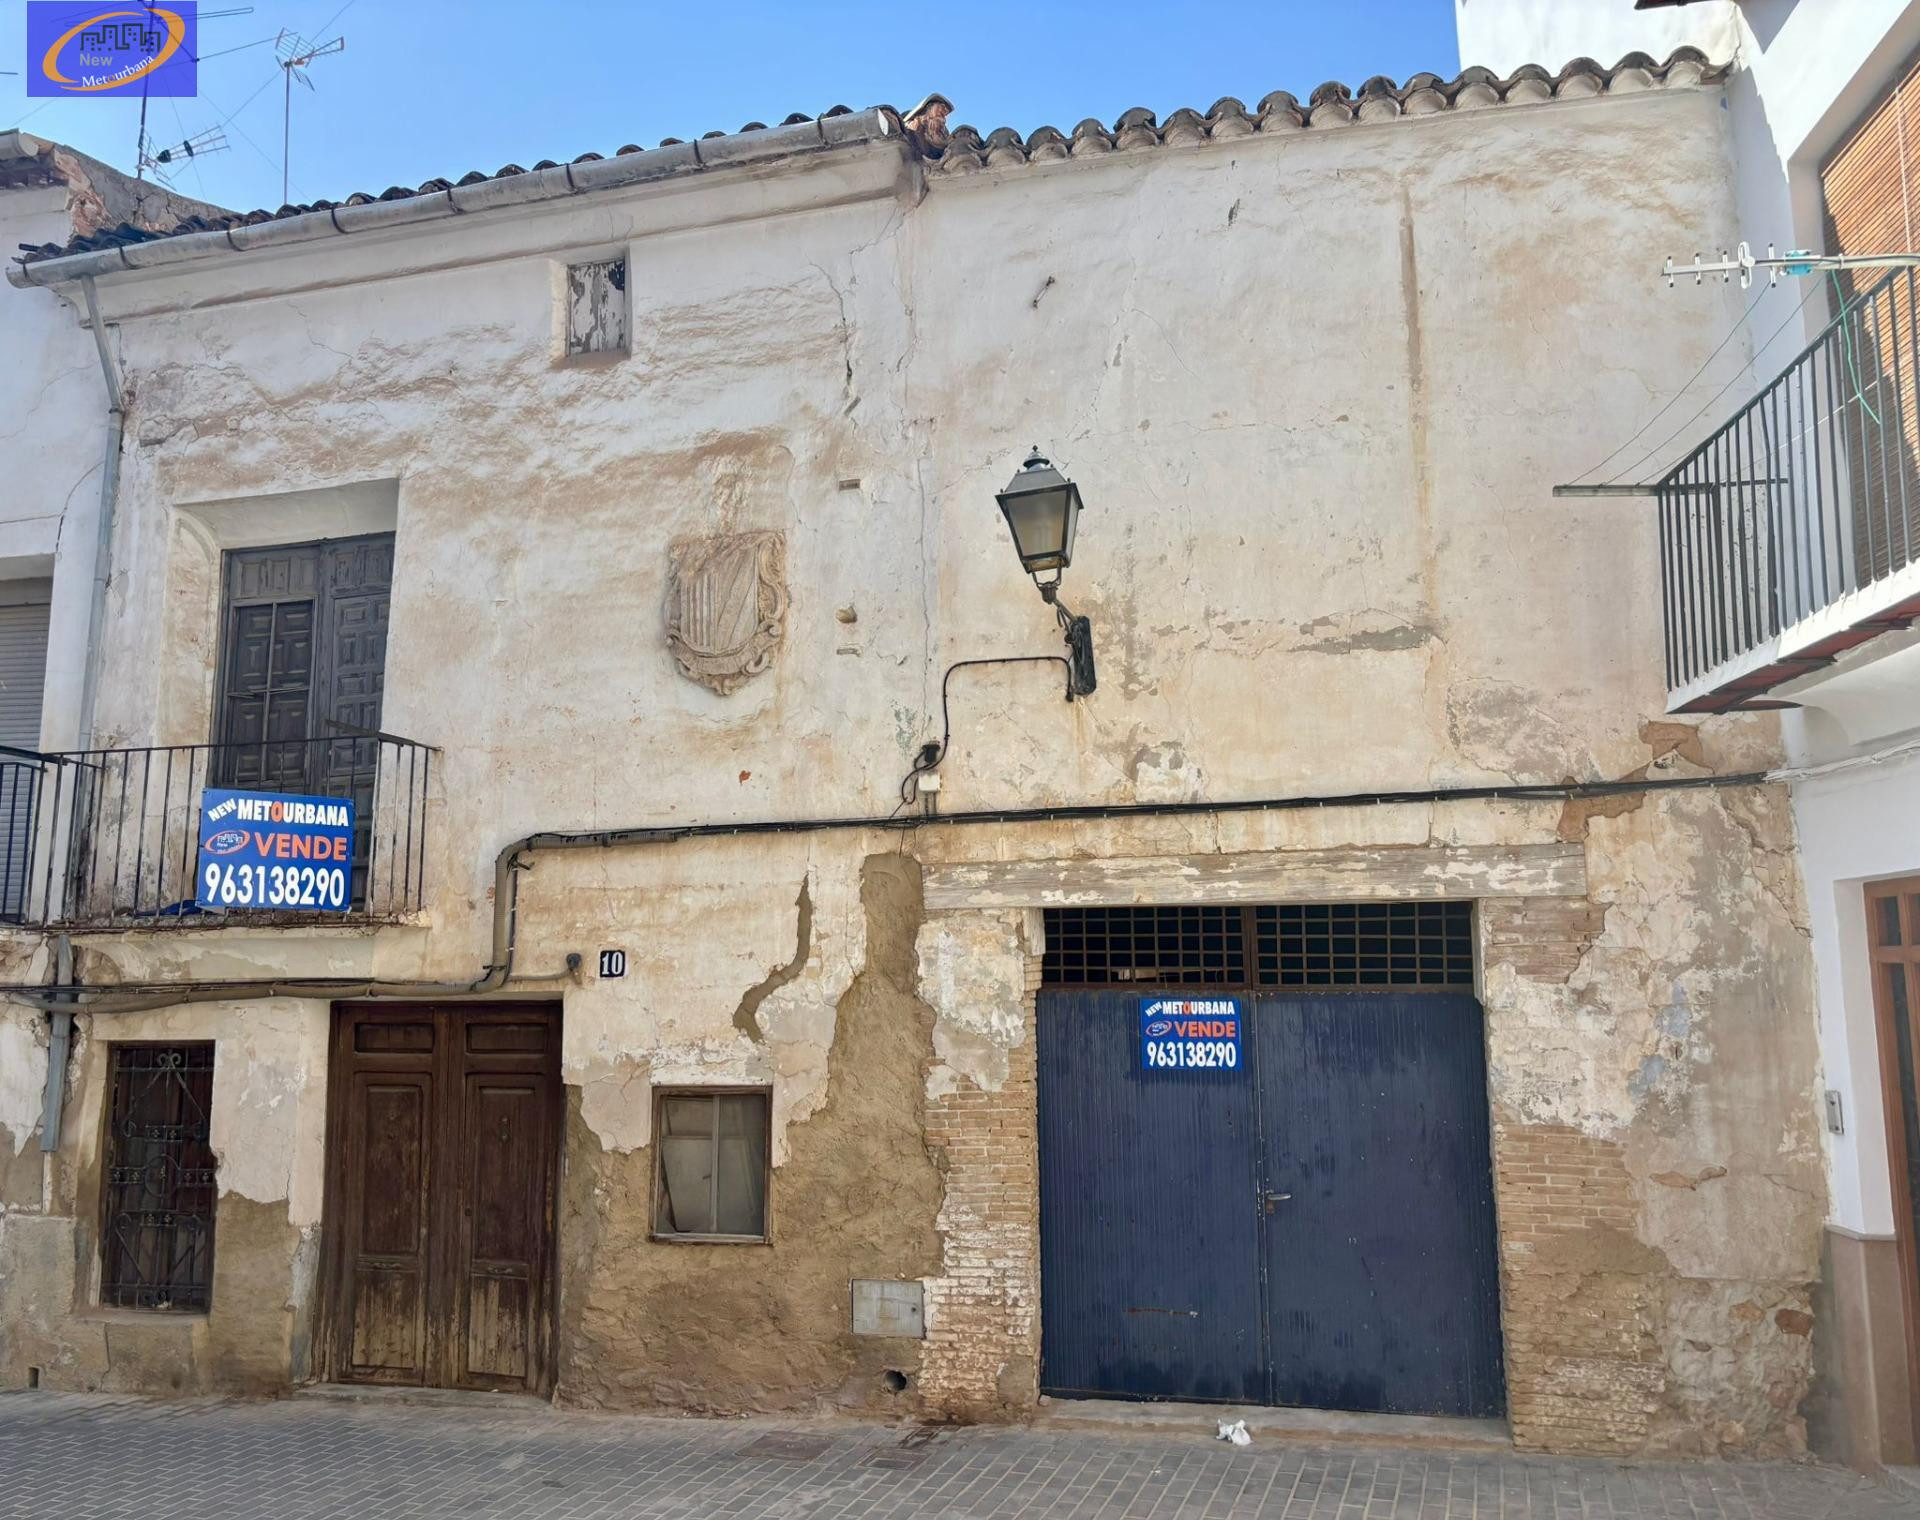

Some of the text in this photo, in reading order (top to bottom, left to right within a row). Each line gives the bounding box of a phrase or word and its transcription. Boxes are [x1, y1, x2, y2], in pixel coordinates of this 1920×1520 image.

[207, 798, 349, 827] NEW METOURBANA
[254, 832, 348, 861] VENDE
[205, 862, 345, 907] 963138290
[601, 951, 624, 975] 10
[1145, 1001, 1235, 1017] NEW METOURBANA
[1174, 1021, 1236, 1038] VENDE
[1146, 1041, 1237, 1068] 963138290
